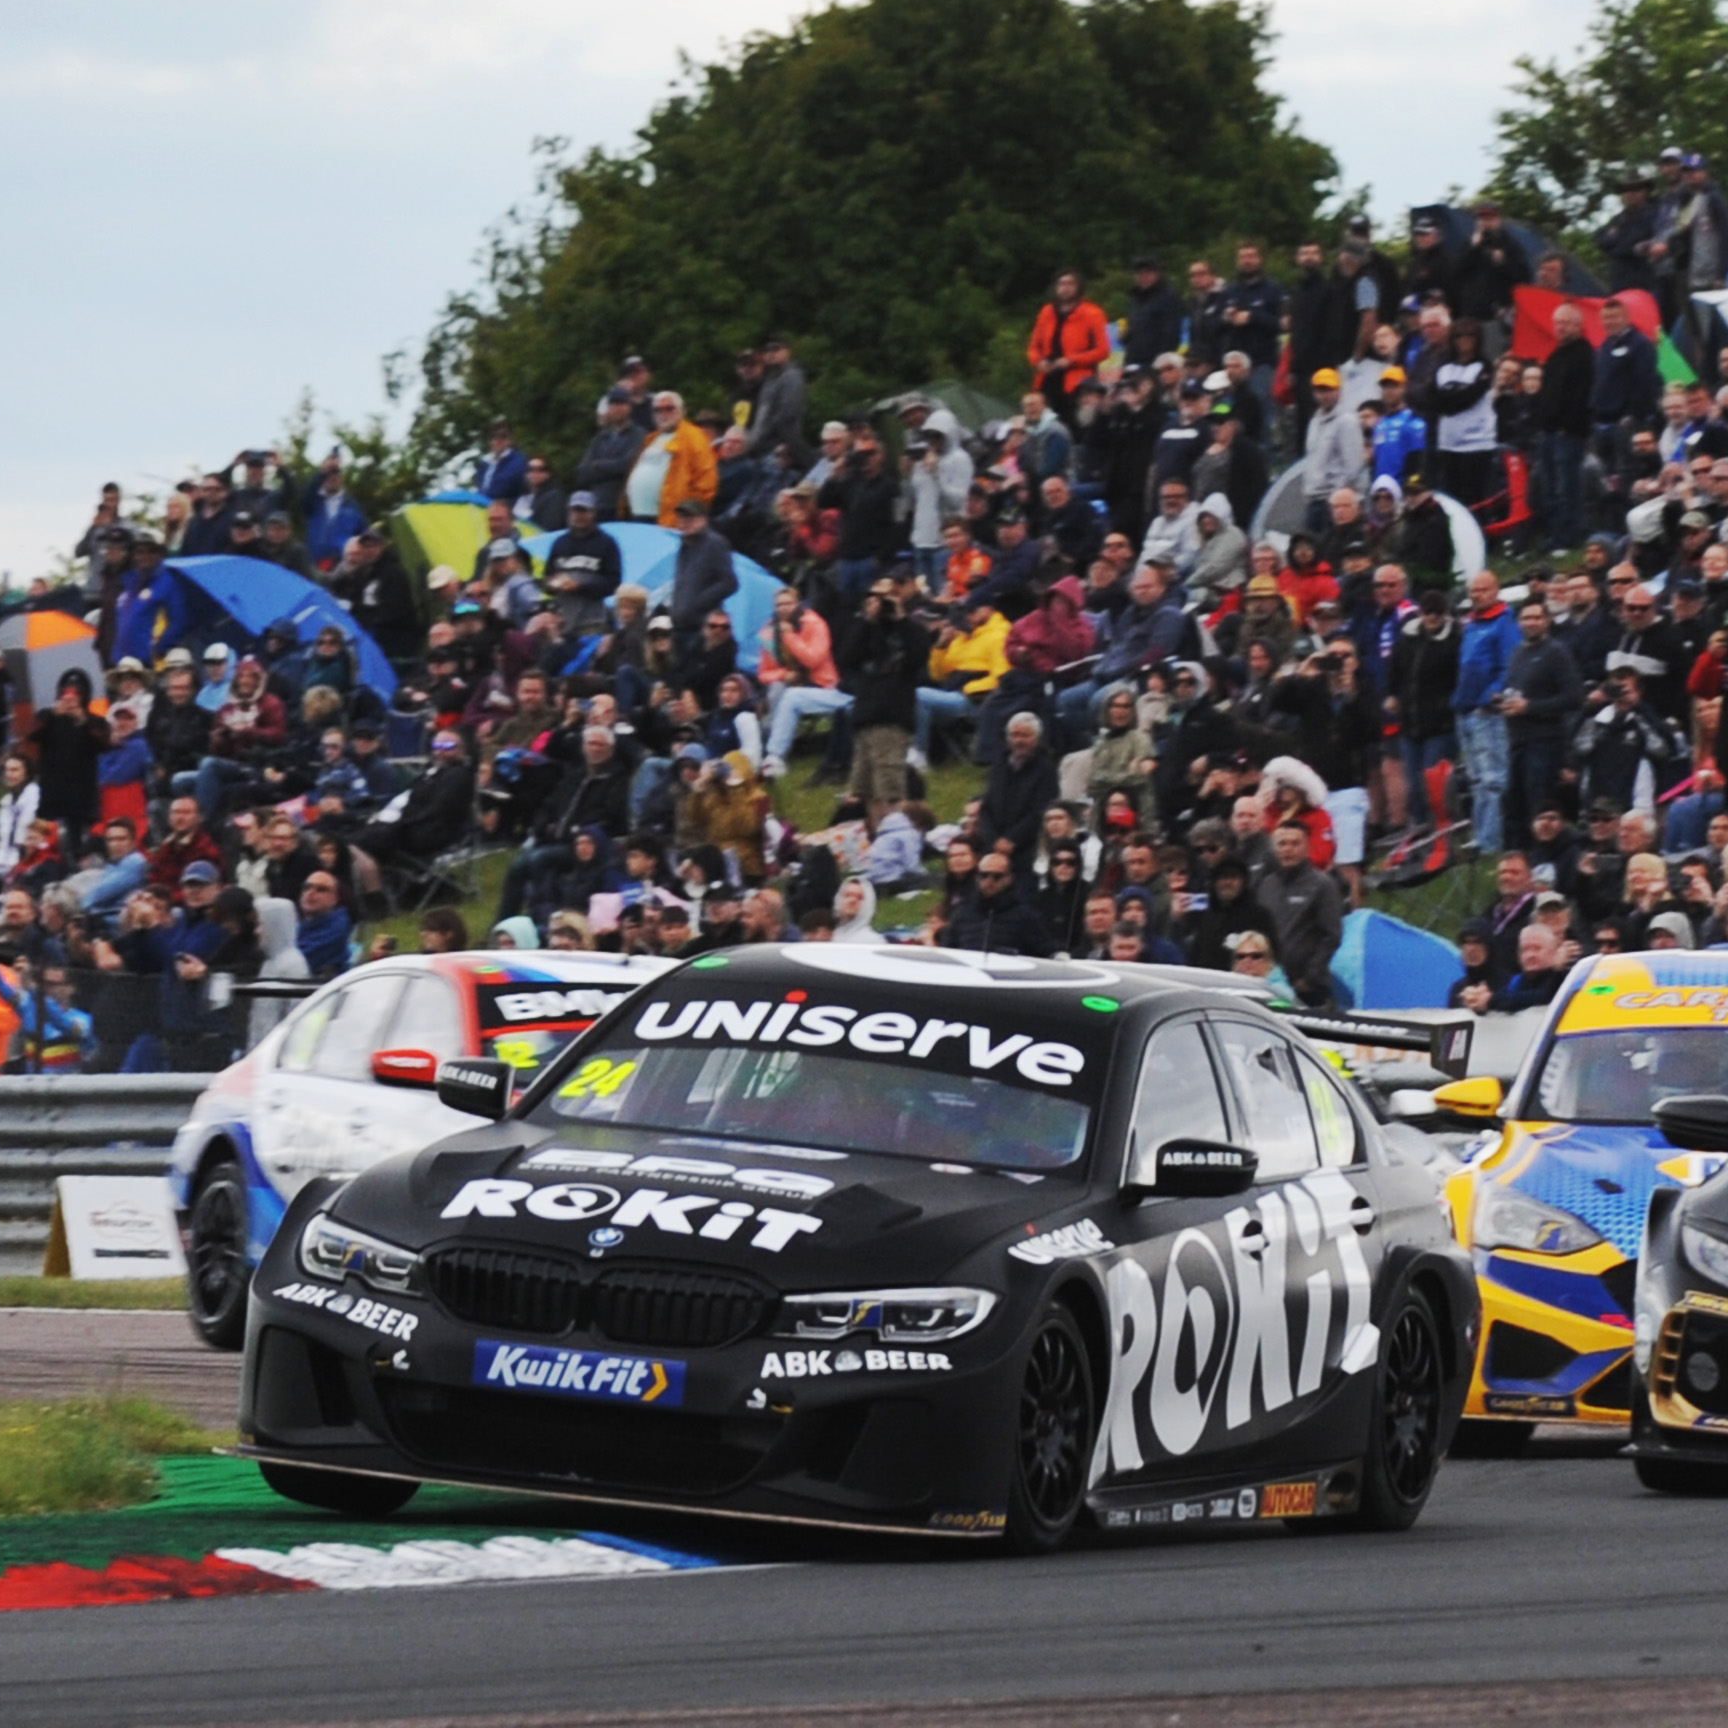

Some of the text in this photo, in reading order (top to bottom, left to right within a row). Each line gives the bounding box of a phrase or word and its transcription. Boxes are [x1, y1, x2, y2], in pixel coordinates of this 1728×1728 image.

[494, 989, 632, 1021] BM
[558, 1058, 637, 1098] 24
[1162, 1152, 1243, 1167] ABK BEER
[595, 1166, 736, 1188] PARTNERSHIP
[273, 1282, 419, 1341] ABK BEER
[760, 1349, 953, 1378] ABK BEER
